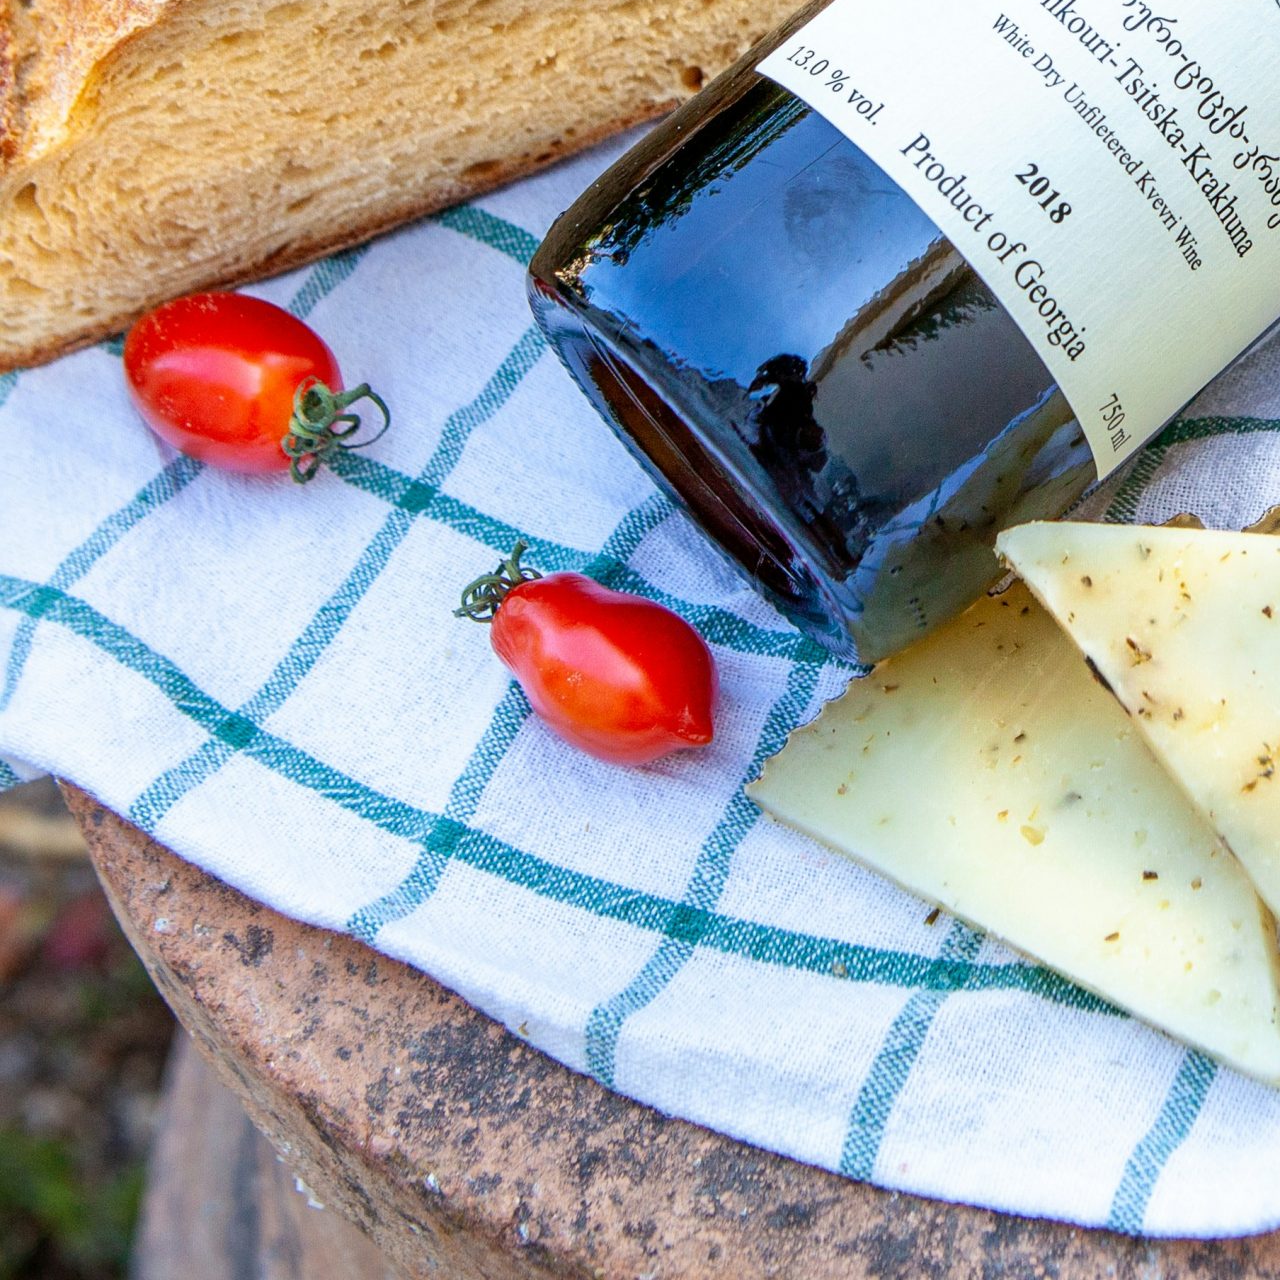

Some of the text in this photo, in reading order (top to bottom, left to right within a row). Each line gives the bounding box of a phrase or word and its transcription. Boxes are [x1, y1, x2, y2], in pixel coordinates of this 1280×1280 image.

[786, 44, 886, 126] 13.0 % vol.
[992, 13, 1203, 272] White Dry Unfiletered Kvevri Wine
[1015, 163, 1073, 225] 2018
[899, 131, 1088, 363] Product of Georgia
[1098, 392, 1133, 453] 750 ml
